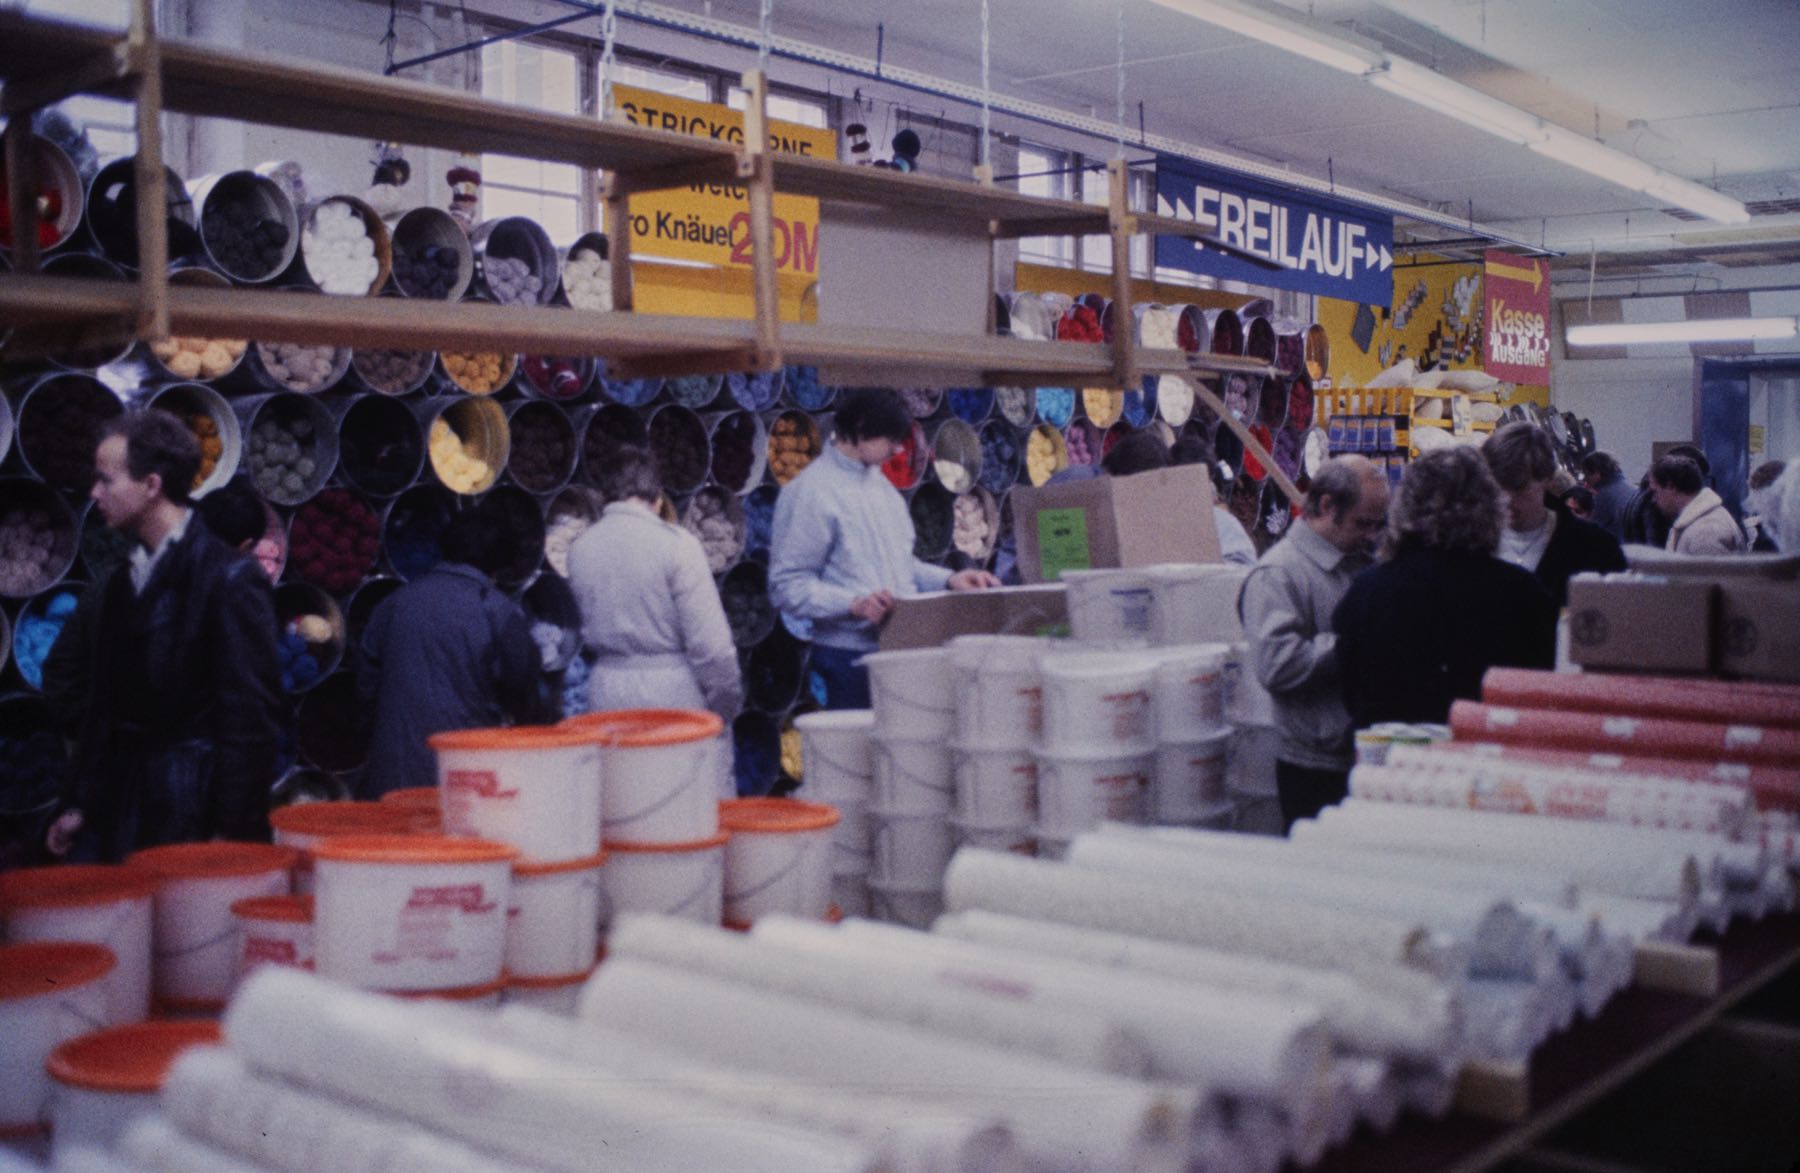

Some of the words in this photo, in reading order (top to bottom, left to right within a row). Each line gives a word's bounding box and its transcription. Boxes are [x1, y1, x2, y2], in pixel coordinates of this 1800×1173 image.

[656, 211, 735, 247] Knäuel
[1195, 185, 1367, 280] FREILAUF
[1491, 298, 1545, 339] Kasse
